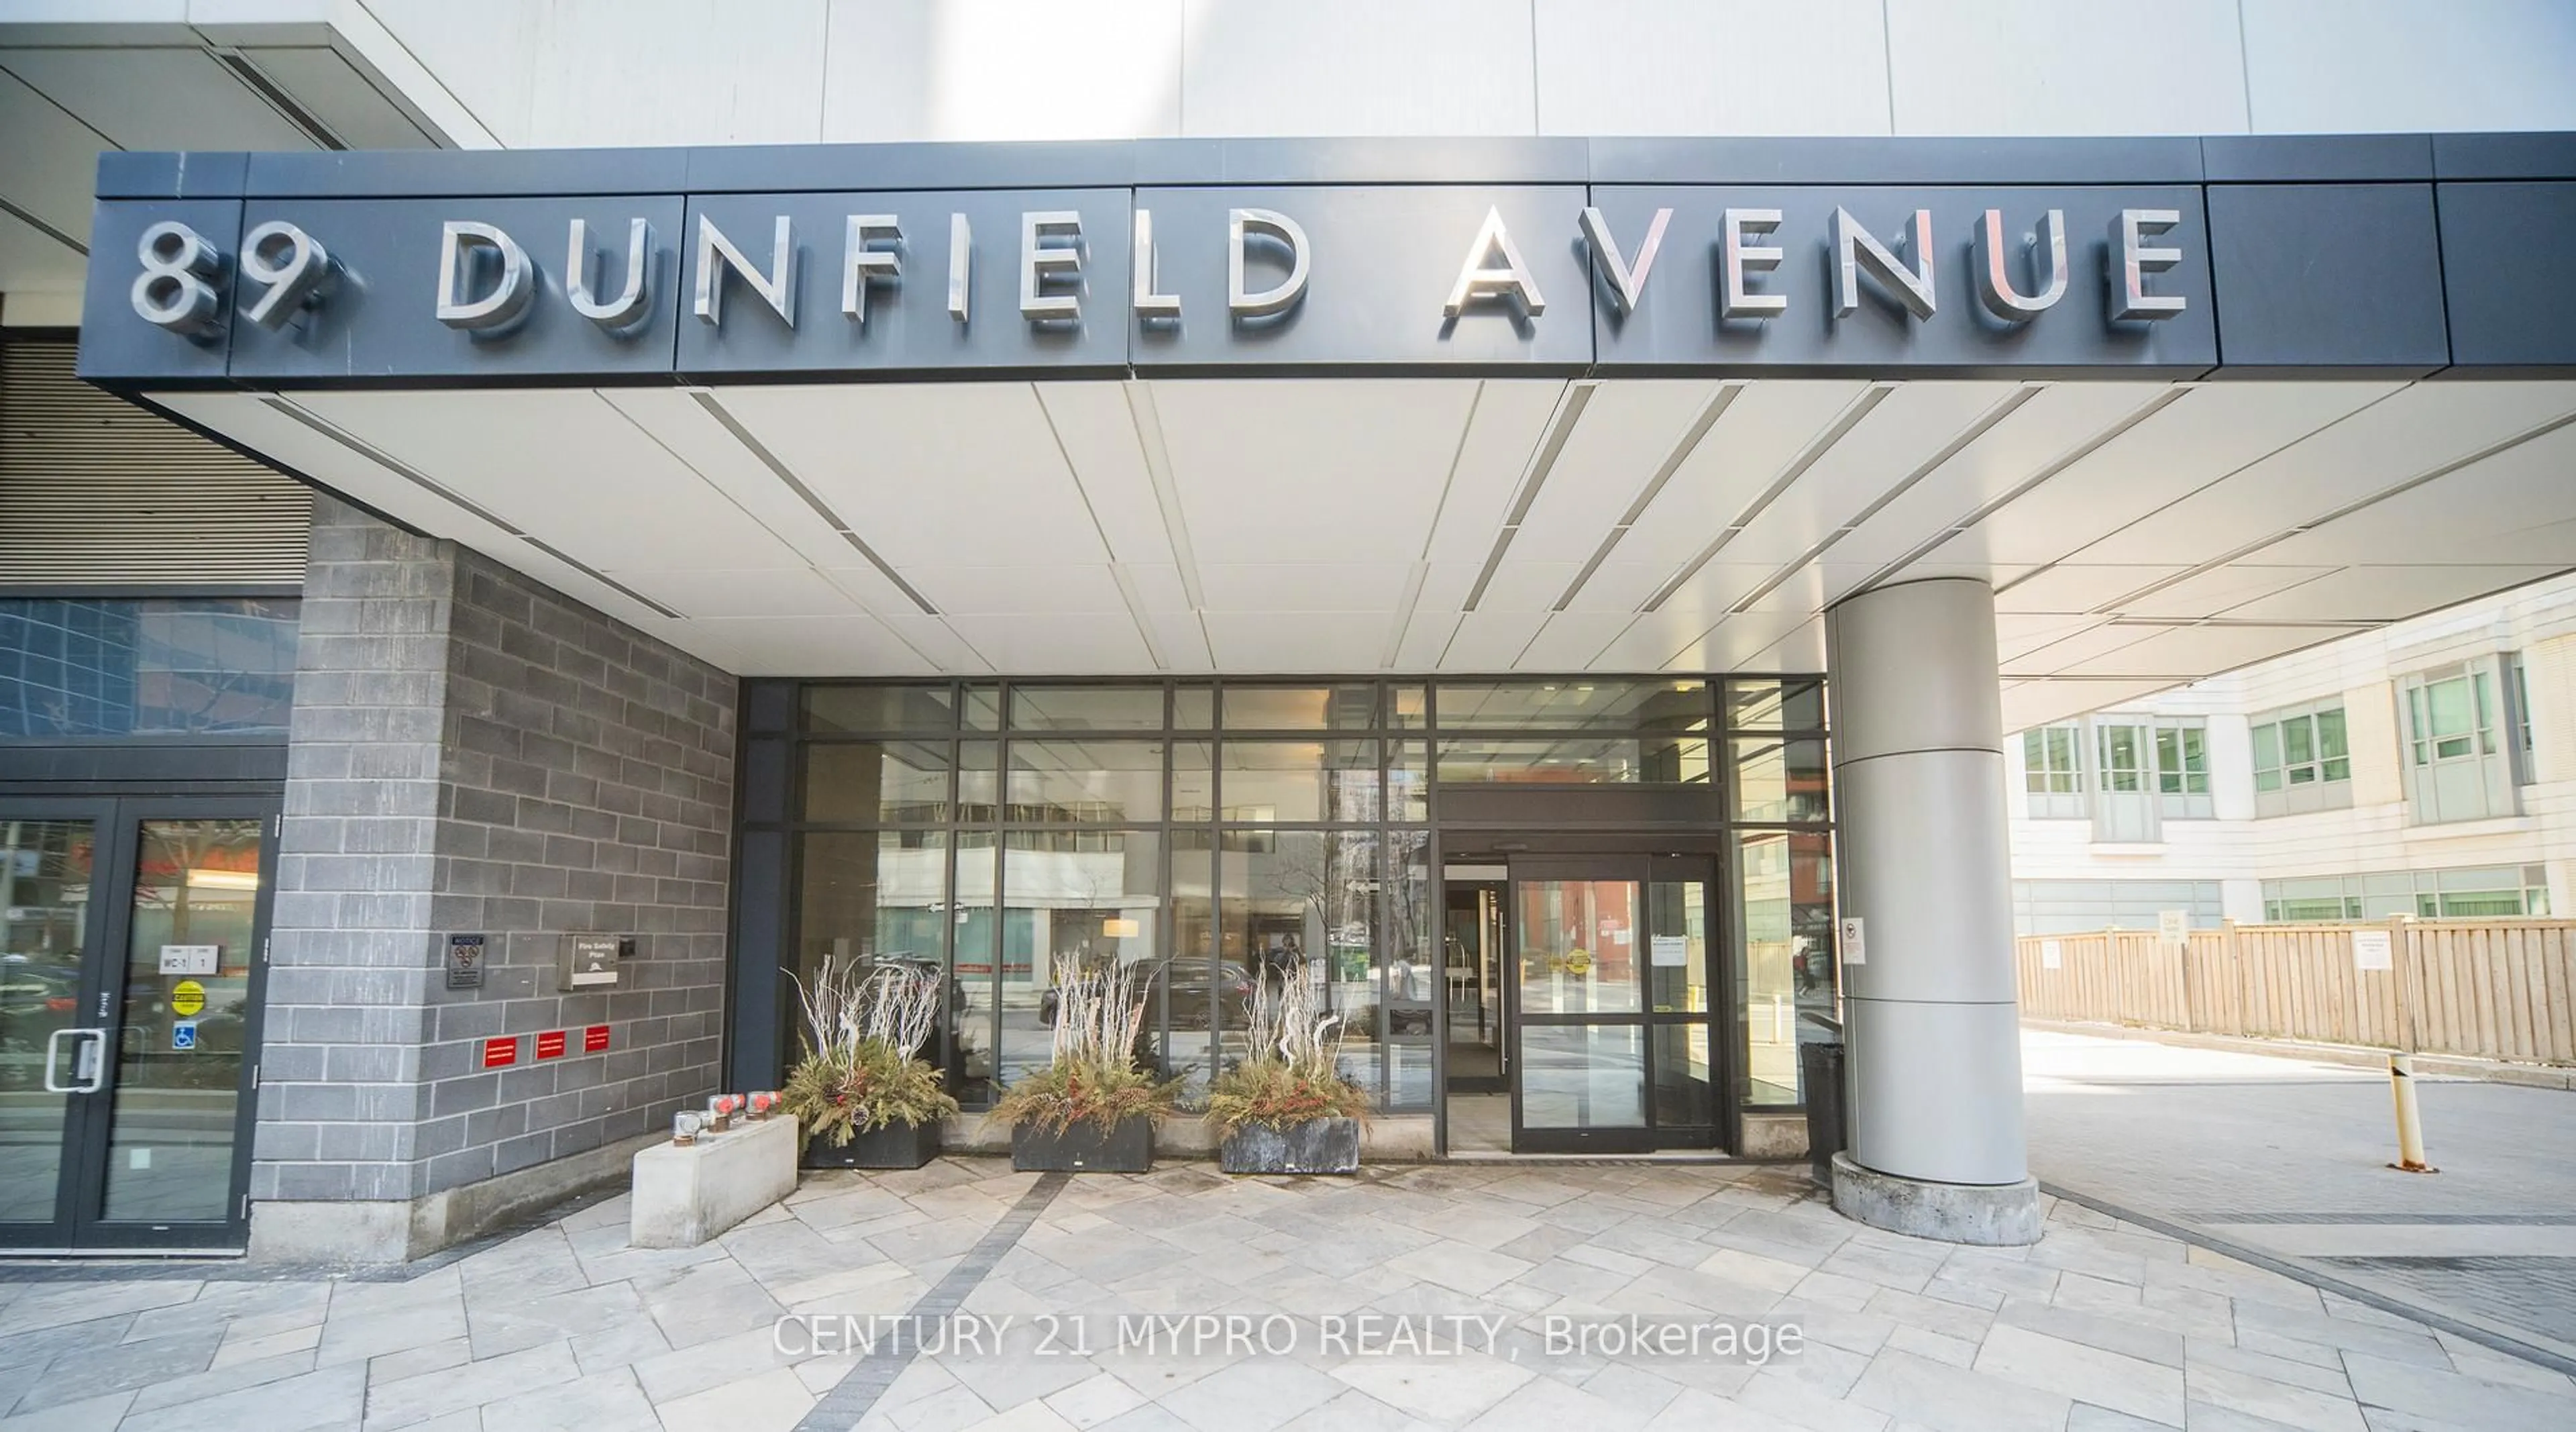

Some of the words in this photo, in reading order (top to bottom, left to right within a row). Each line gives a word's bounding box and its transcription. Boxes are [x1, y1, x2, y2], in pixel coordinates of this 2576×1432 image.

[131, 221, 326, 327] 89
[437, 209, 1310, 329] DUNFIELD
[1444, 205, 2186, 322] AVENUE
